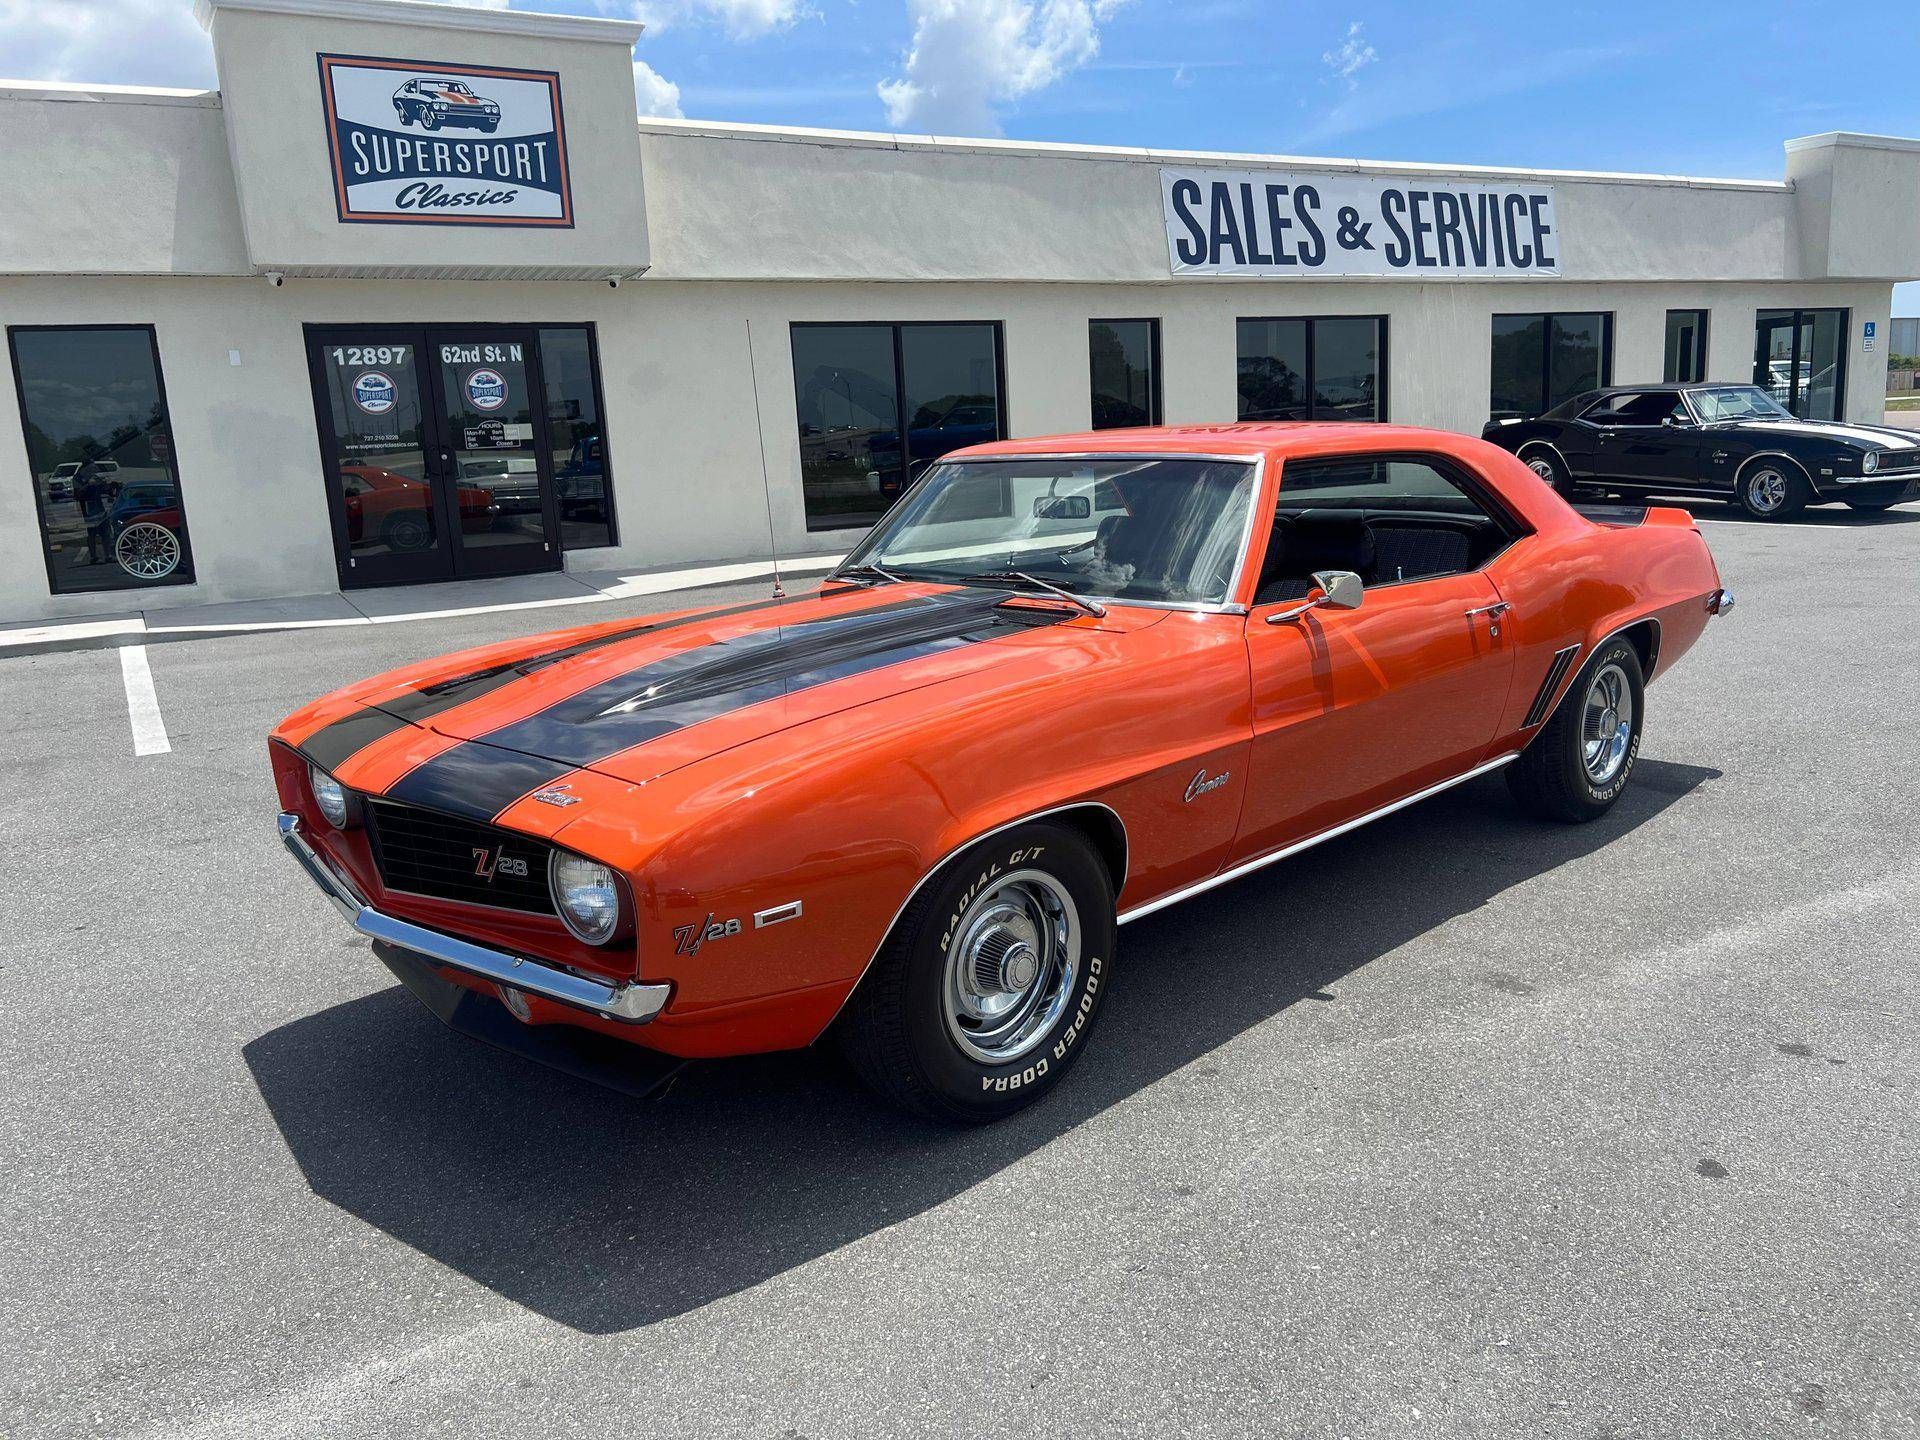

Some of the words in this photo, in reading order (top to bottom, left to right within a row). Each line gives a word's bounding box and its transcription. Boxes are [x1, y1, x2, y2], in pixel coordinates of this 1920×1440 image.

[351, 131, 547, 183] SUPERSPORT
[395, 182, 518, 209] Classics
[1171, 178, 1326, 266] SALES
[1336, 206, 1376, 251] &
[1380, 189, 1555, 268] SERVICE
[333, 347, 406, 366] 12897
[441, 346, 480, 364] 62nd
[484, 345, 506, 363] St.
[510, 345, 522, 362] N
[1614, 734, 1640, 791] COOPER
[1588, 785, 1613, 800] COBRA
[472, 845, 529, 882] Z/28
[940, 862, 1002, 952] RADIAL
[1009, 847, 1045, 865] G/T
[673, 912, 744, 957] Z/28
[1053, 956, 1102, 1060] COOPER
[981, 1058, 1049, 1092] COBRA
